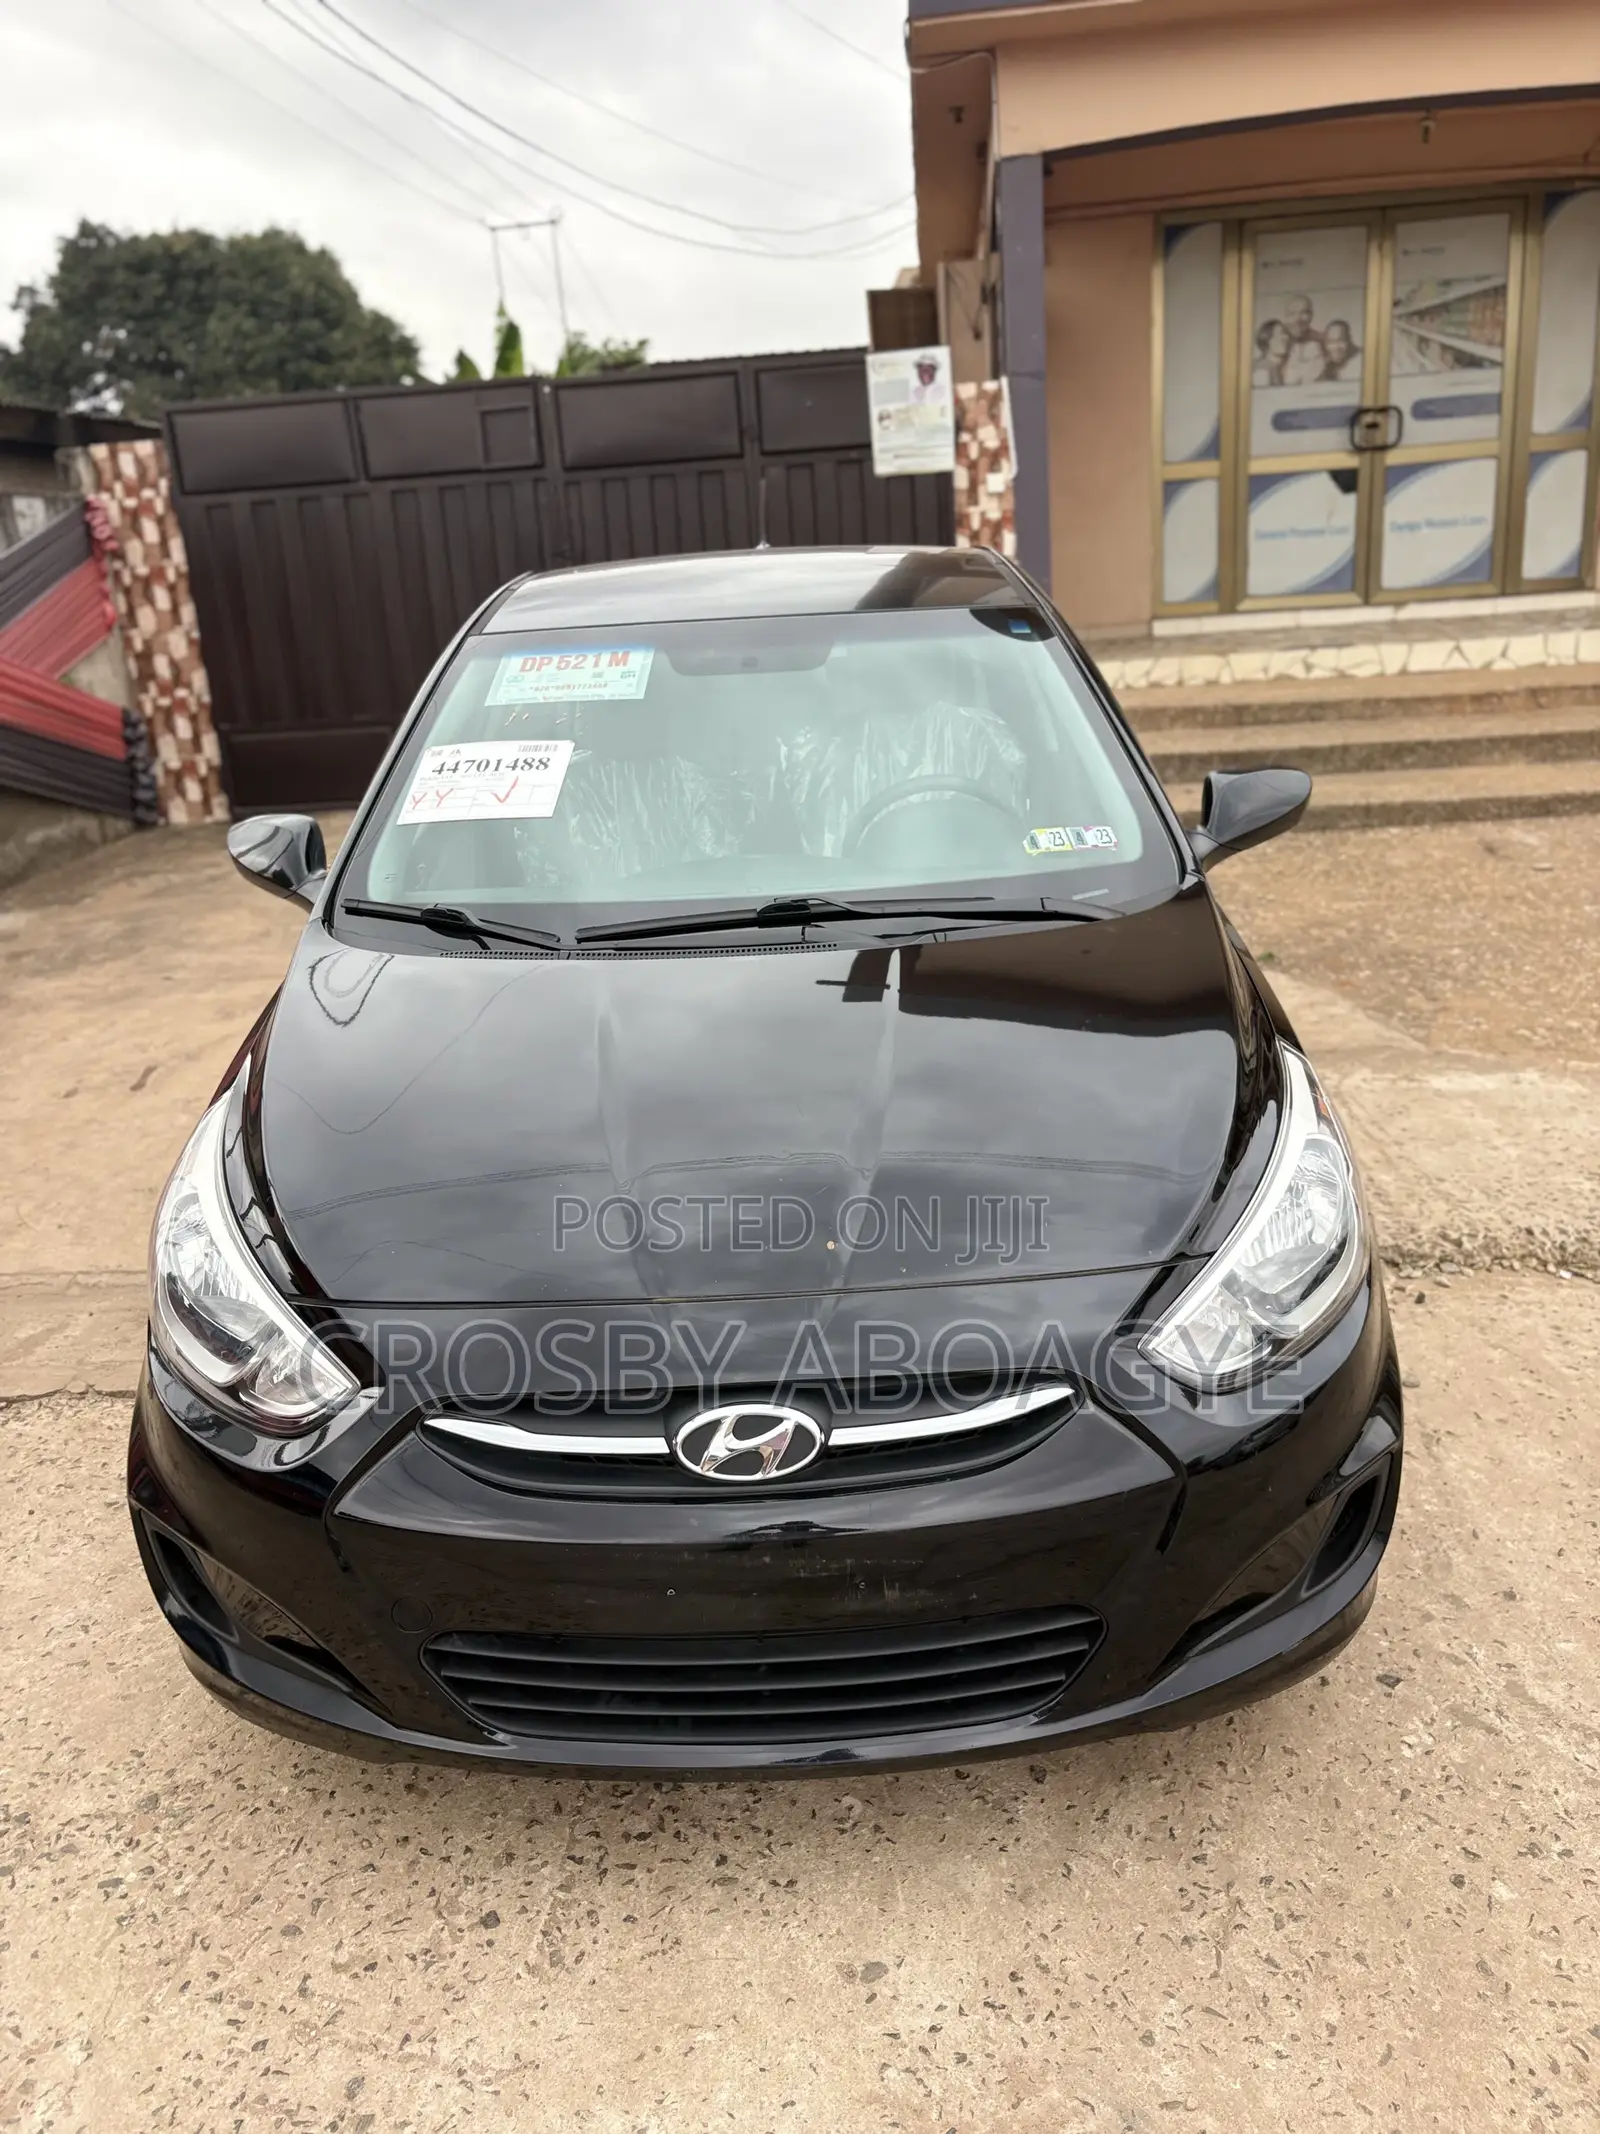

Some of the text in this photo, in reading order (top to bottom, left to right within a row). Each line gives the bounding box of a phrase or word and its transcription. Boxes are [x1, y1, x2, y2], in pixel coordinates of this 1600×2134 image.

[519, 650, 630, 673] DP 521 M
[432, 757, 550, 775] 44701488
[1049, 831, 1065, 847] 23
[1096, 829, 1112, 844] 23
